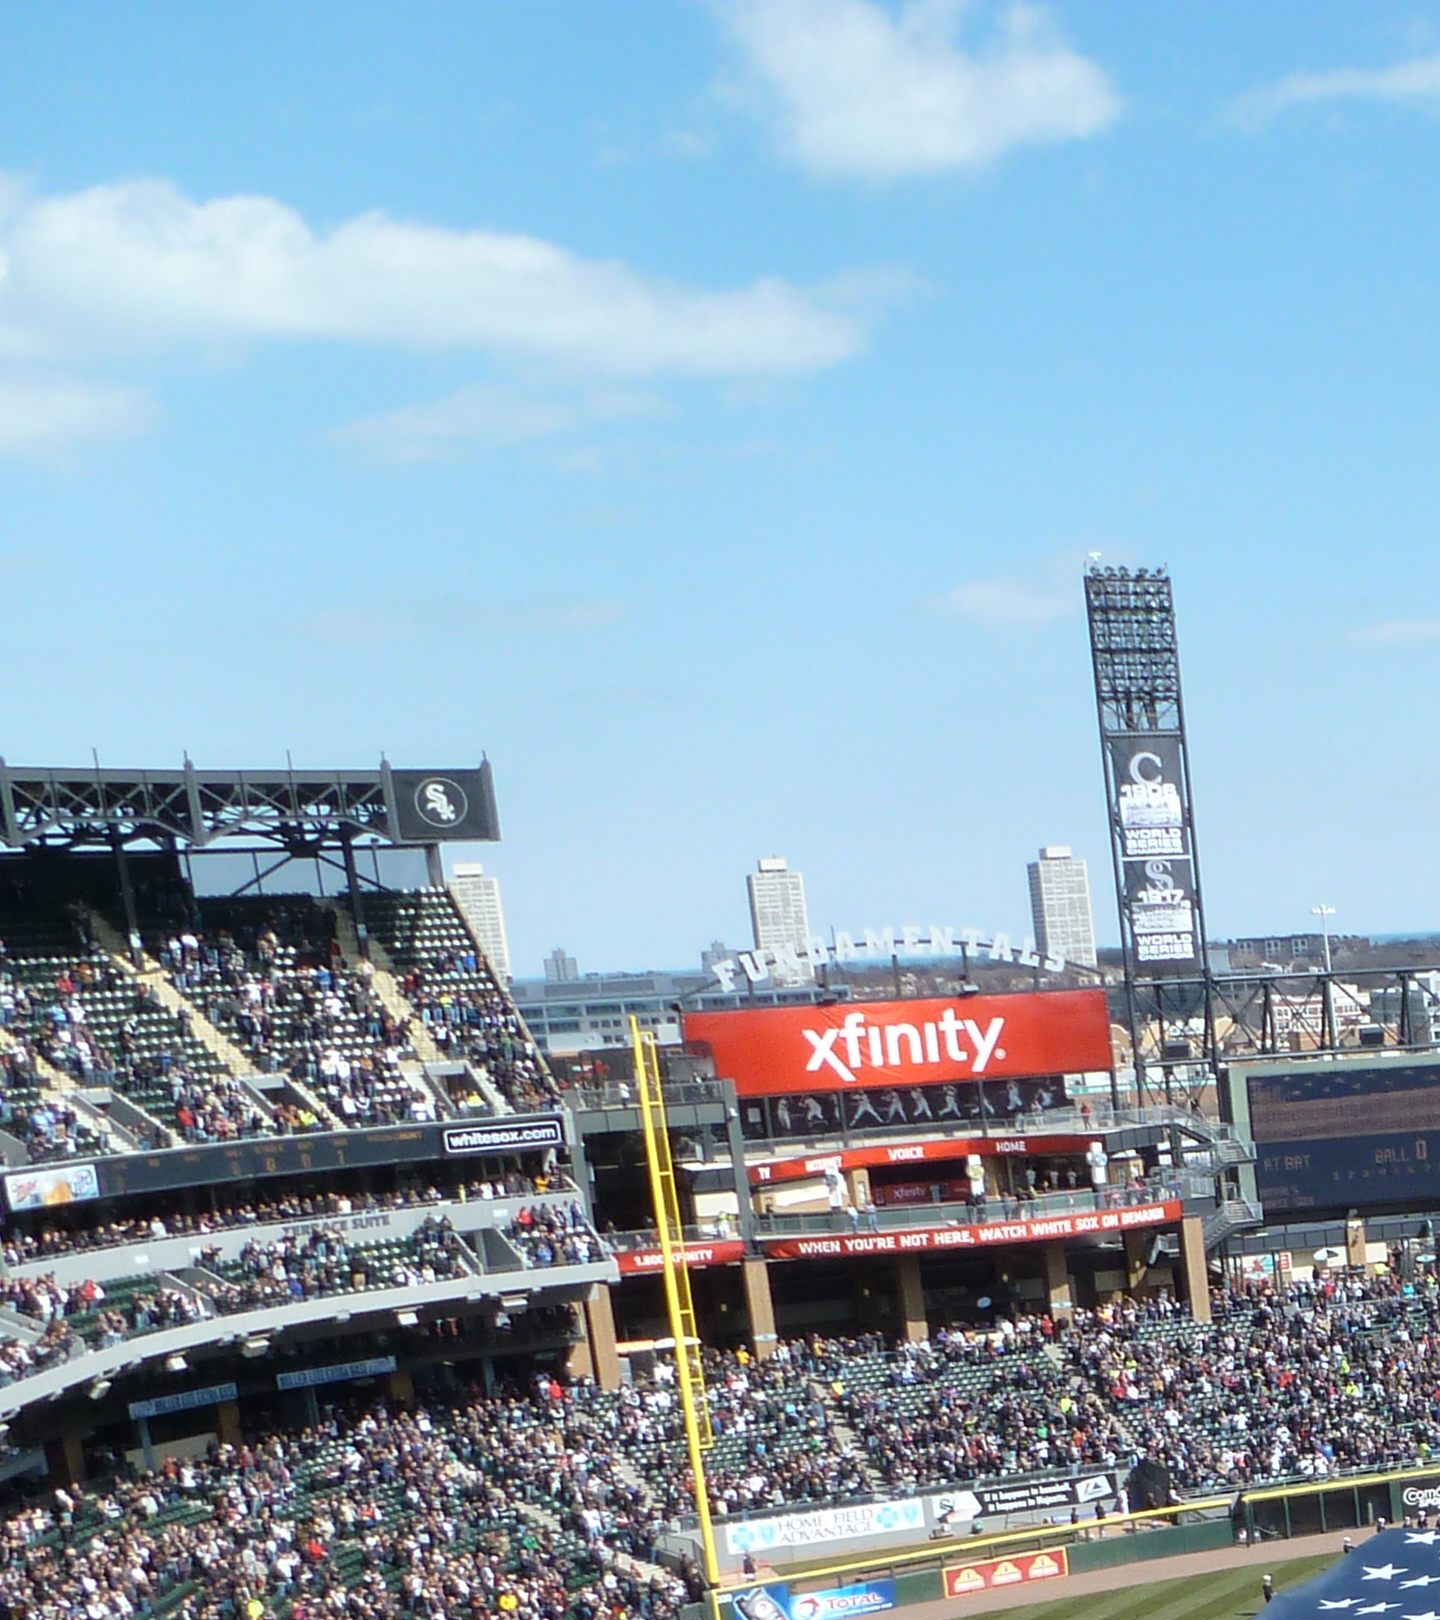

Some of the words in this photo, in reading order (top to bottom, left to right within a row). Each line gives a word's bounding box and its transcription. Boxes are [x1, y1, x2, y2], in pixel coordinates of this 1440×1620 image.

[1121, 783, 1177, 799] 1906
[1125, 828, 1182, 840] WORLD
[1126, 838, 1182, 849] SERIES
[1138, 889, 1185, 904] 1917
[1137, 934, 1193, 946] WORLD
[1138, 944, 1194, 954] SERIES
[711, 926, 1067, 992] FUNDAMENTALS
[802, 1008, 1005, 1082] xfinity
[450, 1127, 557, 1149] whitesox.com
[996, 1140, 1027, 1152] HOME
[887, 1146, 925, 1161] VOICE
[1374, 1147, 1411, 1164] BALL
[1284, 1153, 1312, 1171] BAT
[758, 1167, 771, 1180] TV
[352, 1213, 391, 1230] SUITE
[798, 1240, 840, 1255] WHEN
[845, 1236, 896, 1252] YOU'RE
[900, 1233, 929, 1248] NOT
[934, 1230, 975, 1245] HERE,
[980, 1226, 1028, 1241] WATCH
[1031, 1221, 1073, 1237] WHITE
[1076, 1217, 1100, 1232] SOX
[1102, 1214, 1120, 1228] ON
[778, 1514, 826, 1534] HOME
[833, 1508, 874, 1524] FIELD
[780, 1521, 876, 1544] ADVANTAGE
